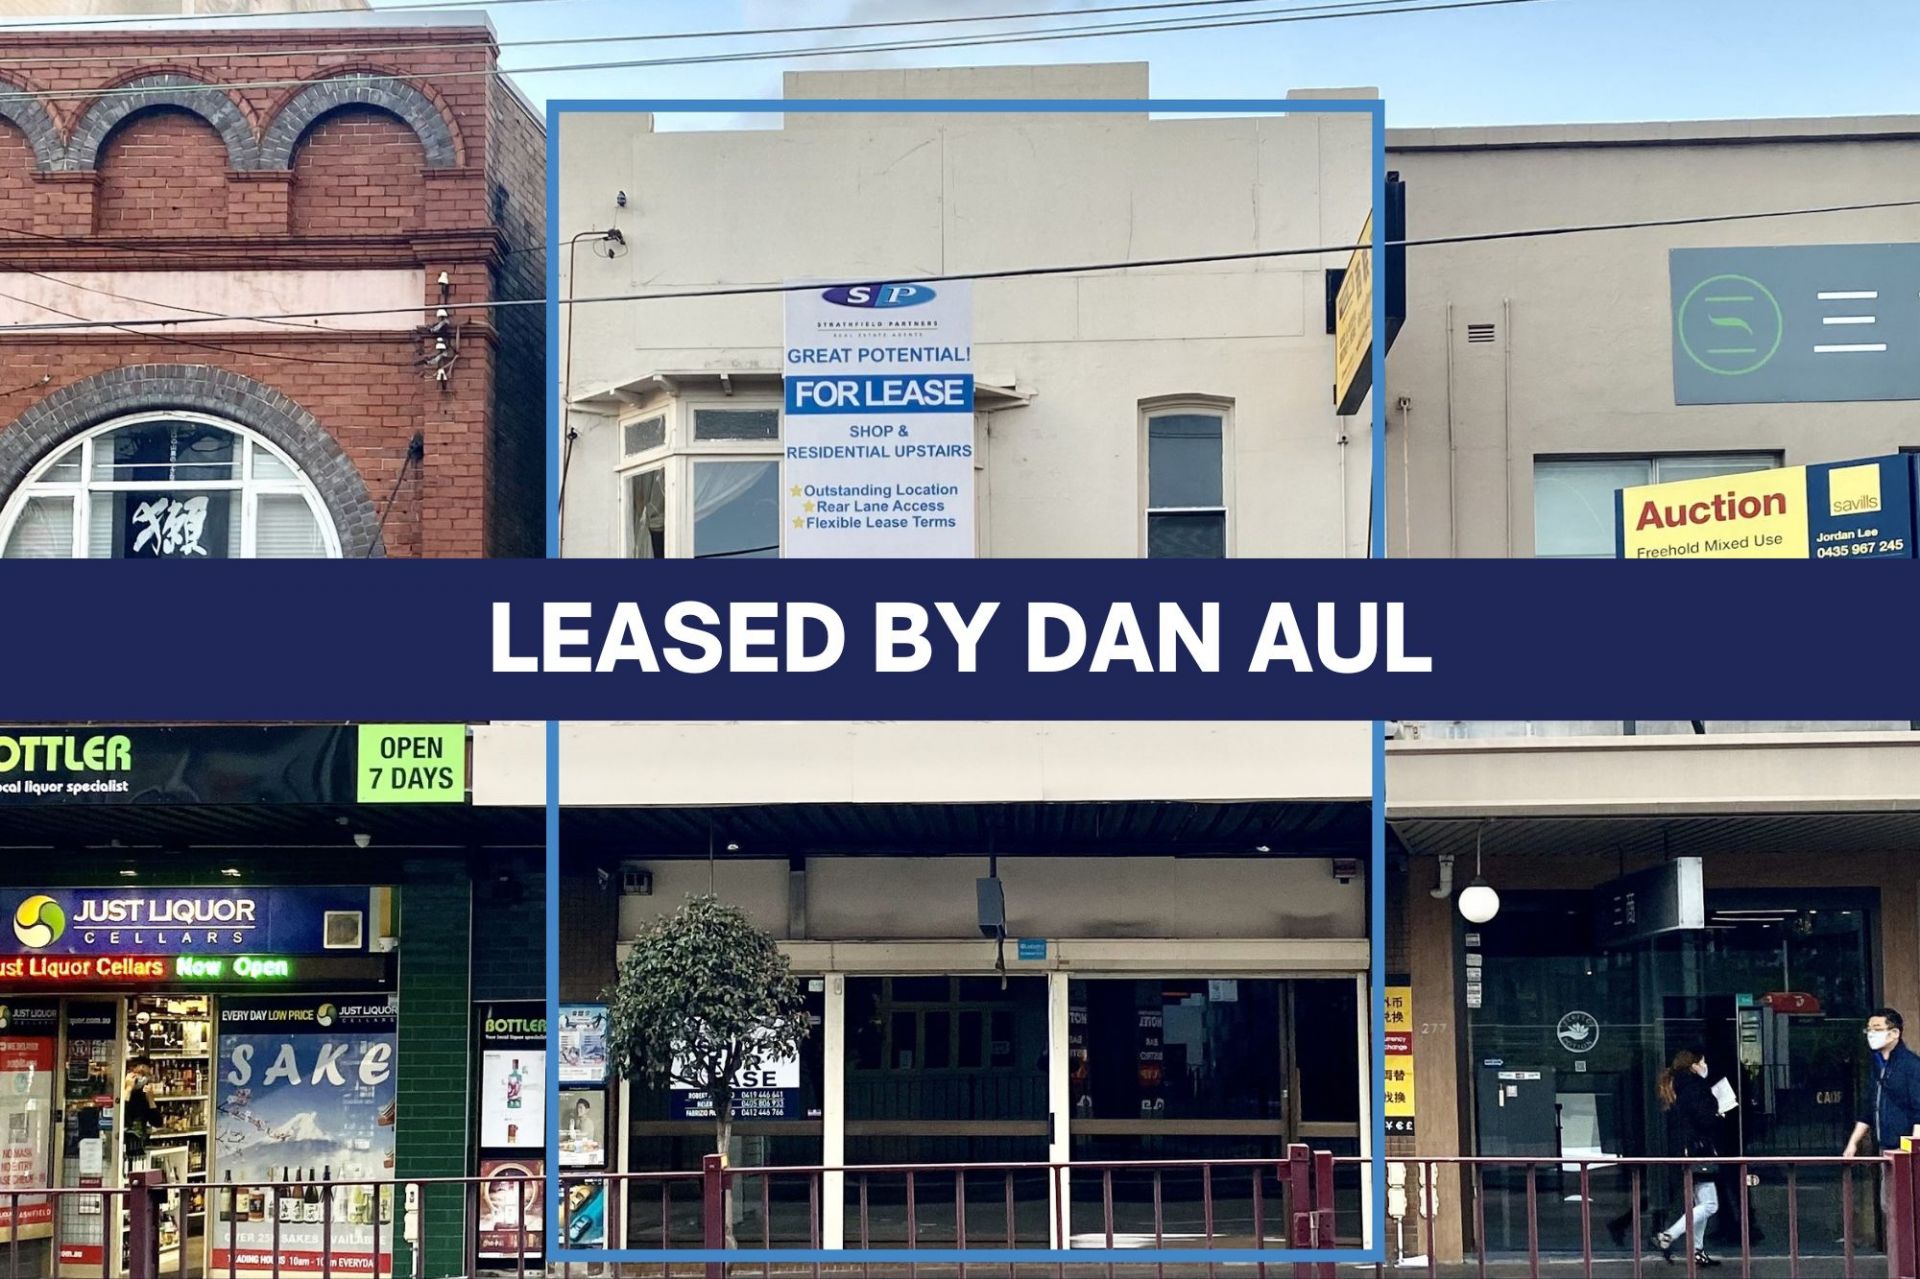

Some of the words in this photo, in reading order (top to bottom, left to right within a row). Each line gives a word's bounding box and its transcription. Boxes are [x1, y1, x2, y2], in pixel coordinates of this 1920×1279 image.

[787, 348, 852, 364] GREAT
[857, 346, 971, 363] POTENTIAL!
[795, 381, 861, 408] FOR
[865, 379, 965, 406] LEASE
[849, 425, 894, 438] SHOP
[897, 424, 909, 437] &
[787, 446, 890, 459] RESIDENTIAL
[894, 444, 973, 457] UPSTAIRS
[804, 484, 892, 498] Outstanding
[896, 483, 959, 497] Location
[817, 501, 851, 513] Rear
[854, 500, 889, 513] Lane
[892, 499, 945, 512] Access
[1635, 490, 1787, 531] Auction
[1832, 494, 1878, 513] savills
[806, 516, 862, 529] Flexible
[866, 516, 908, 528] Lease
[912, 515, 956, 528] Terms
[1816, 529, 1855, 543] Jordan
[1857, 527, 1879, 539] Lee
[1637, 541, 1699, 559] Freehold
[1704, 536, 1750, 552] Mixed
[1754, 533, 1783, 546] Use
[1816, 545, 1849, 559] 0435
[1851, 542, 1876, 556] 967
[1879, 539, 1904, 553] 245
[379, 736, 443, 760] OPEN
[369, 767, 383, 789] 7
[390, 767, 453, 789] DAYS
[24, 780, 63, 796] liquor
[66, 779, 129, 796] specialist
[73, 899, 144, 922] JUST
[149, 899, 255, 926] LIQUOR
[84, 931, 243, 944] CELLARS
[29, 958, 90, 978] Liquor
[96, 958, 164, 976] Cellars
[176, 957, 222, 976] Now
[233, 957, 288, 978] Open
[221, 1010, 249, 1021] EVERY
[250, 1010, 268, 1021] DAY
[268, 1010, 288, 1021] LOW
[288, 1009, 314, 1021] PRICE
[339, 1006, 362, 1015] JUST
[363, 1005, 398, 1016] LIQUOR
[485, 1018, 547, 1033] BOTTLER
[1421, 1023, 1448, 1035] 277
[227, 1042, 392, 1086] SAKE
[224, 1233, 256, 1243] OER
[258, 1233, 274, 1243] 25
[280, 1233, 319, 1244] SAKES
[322, 1233, 386, 1246] VAILABE
[227, 1254, 259, 1264] TADING
[260, 1255, 286, 1265] HOUS
[338, 1258, 375, 1269] EVERYDA
